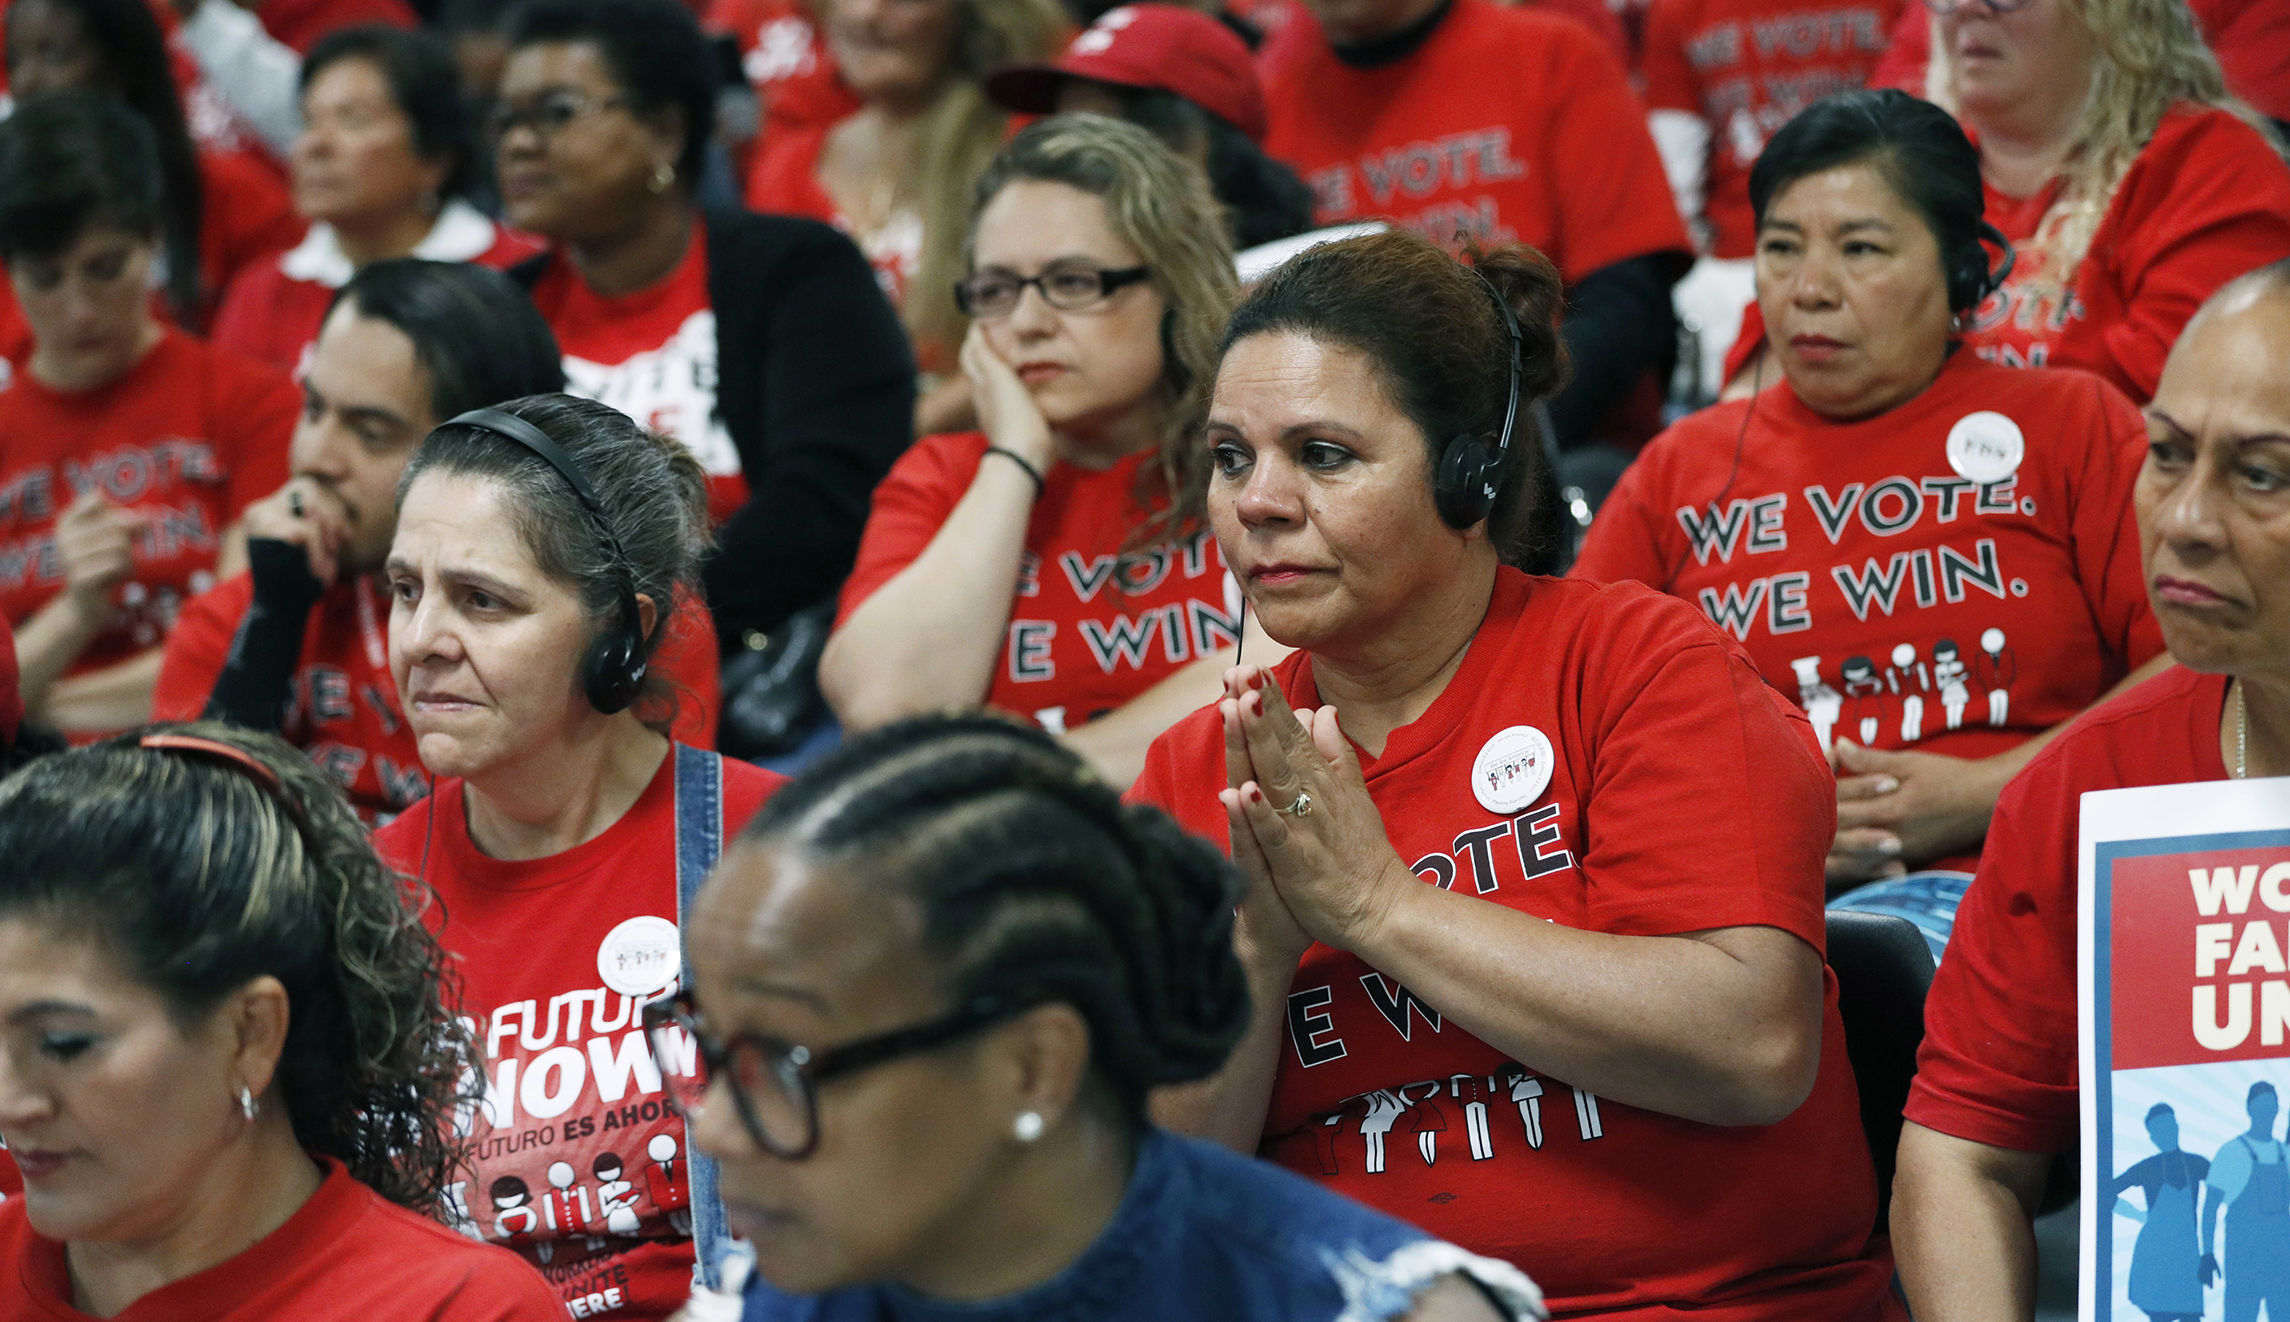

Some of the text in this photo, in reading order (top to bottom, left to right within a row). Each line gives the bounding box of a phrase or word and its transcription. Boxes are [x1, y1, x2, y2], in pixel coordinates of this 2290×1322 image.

[1305, 124, 1531, 218] E VOTE.
[1056, 528, 1228, 604] VOT
[1676, 474, 2036, 566] WE VOTE.
[1698, 537, 2029, 643] WE WIN.
[1008, 619, 1057, 683] E
[1409, 802, 1581, 895] OTE
[1286, 984, 1348, 1069] E
[453, 1028, 676, 1140] NOW
[563, 1115, 596, 1142] ES
